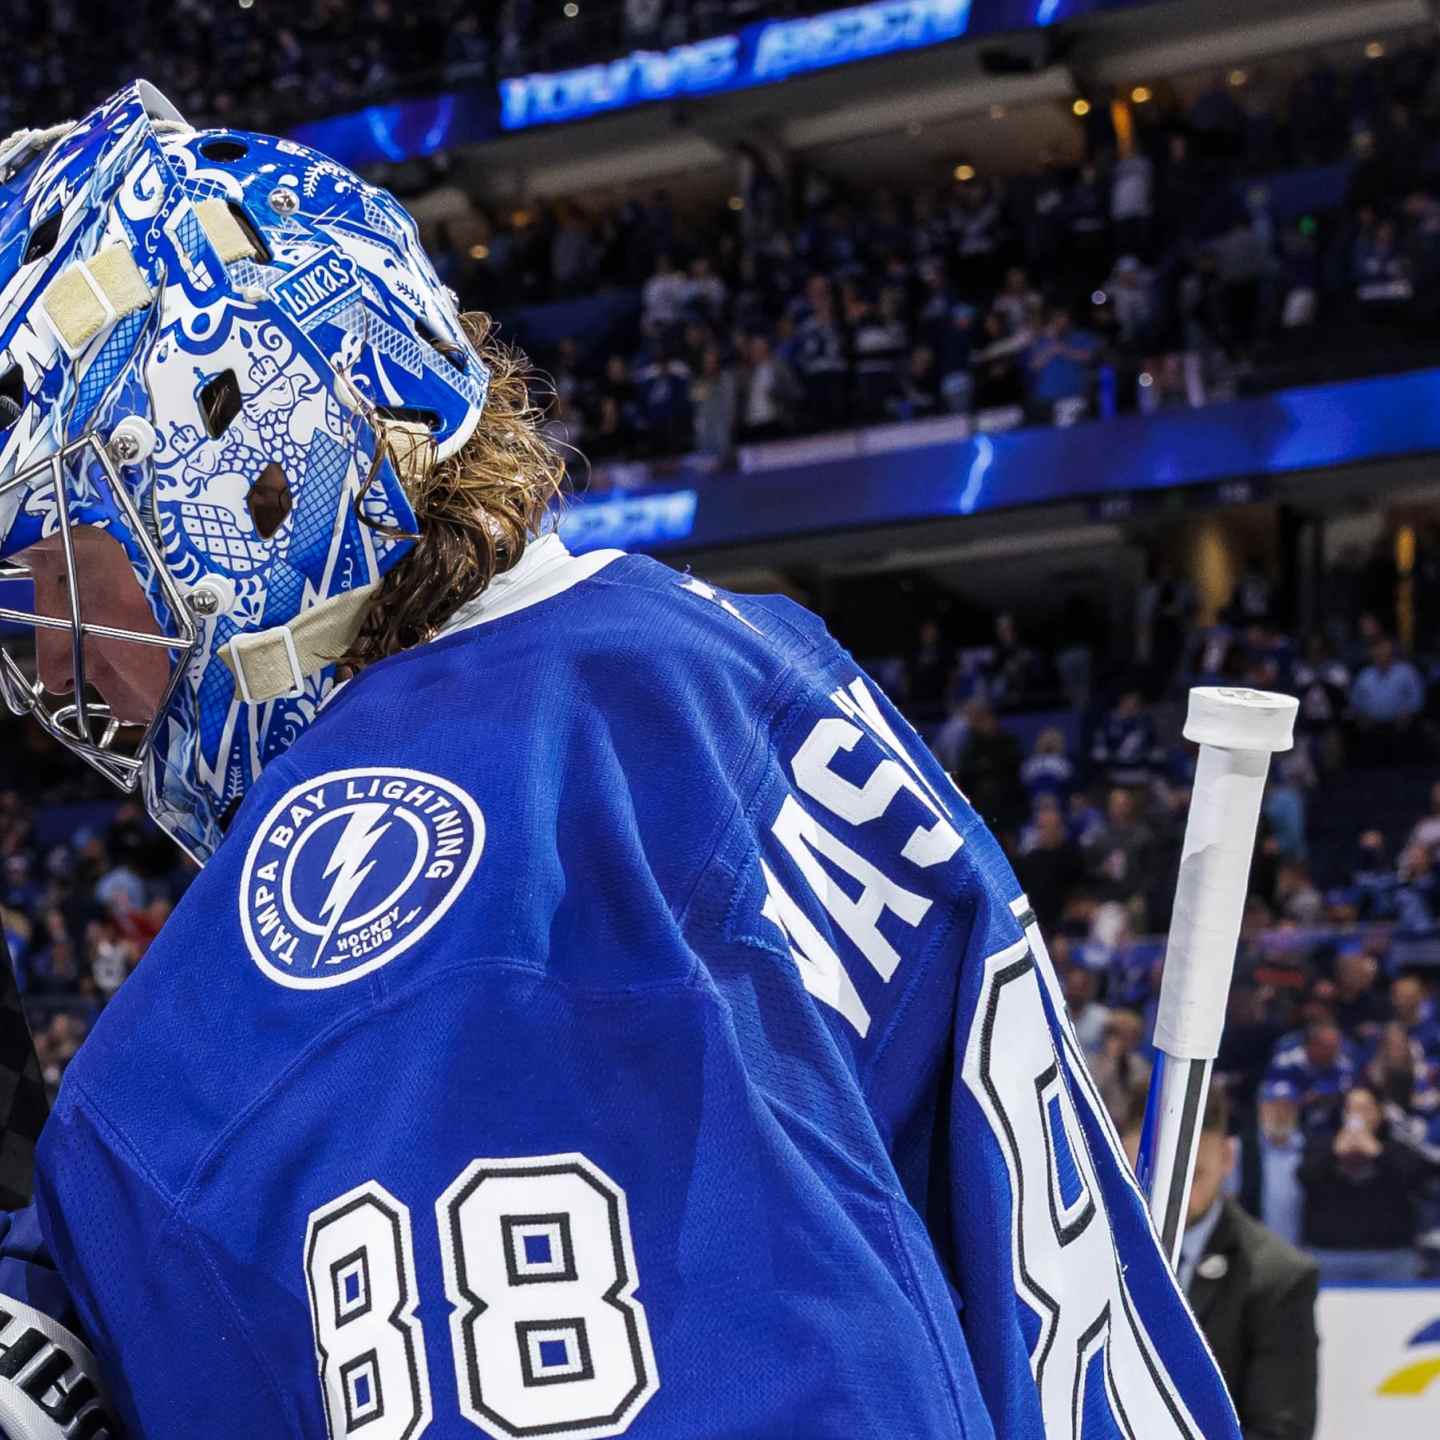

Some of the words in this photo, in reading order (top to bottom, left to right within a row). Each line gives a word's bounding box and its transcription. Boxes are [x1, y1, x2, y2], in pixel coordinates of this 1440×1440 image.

[269, 788, 327, 849] BAY
[346, 779, 465, 880] LIGHTNING
[254, 860, 301, 965] TAMPA
[336, 907, 400, 950] HOCKEY
[351, 930, 393, 958] CLUB
